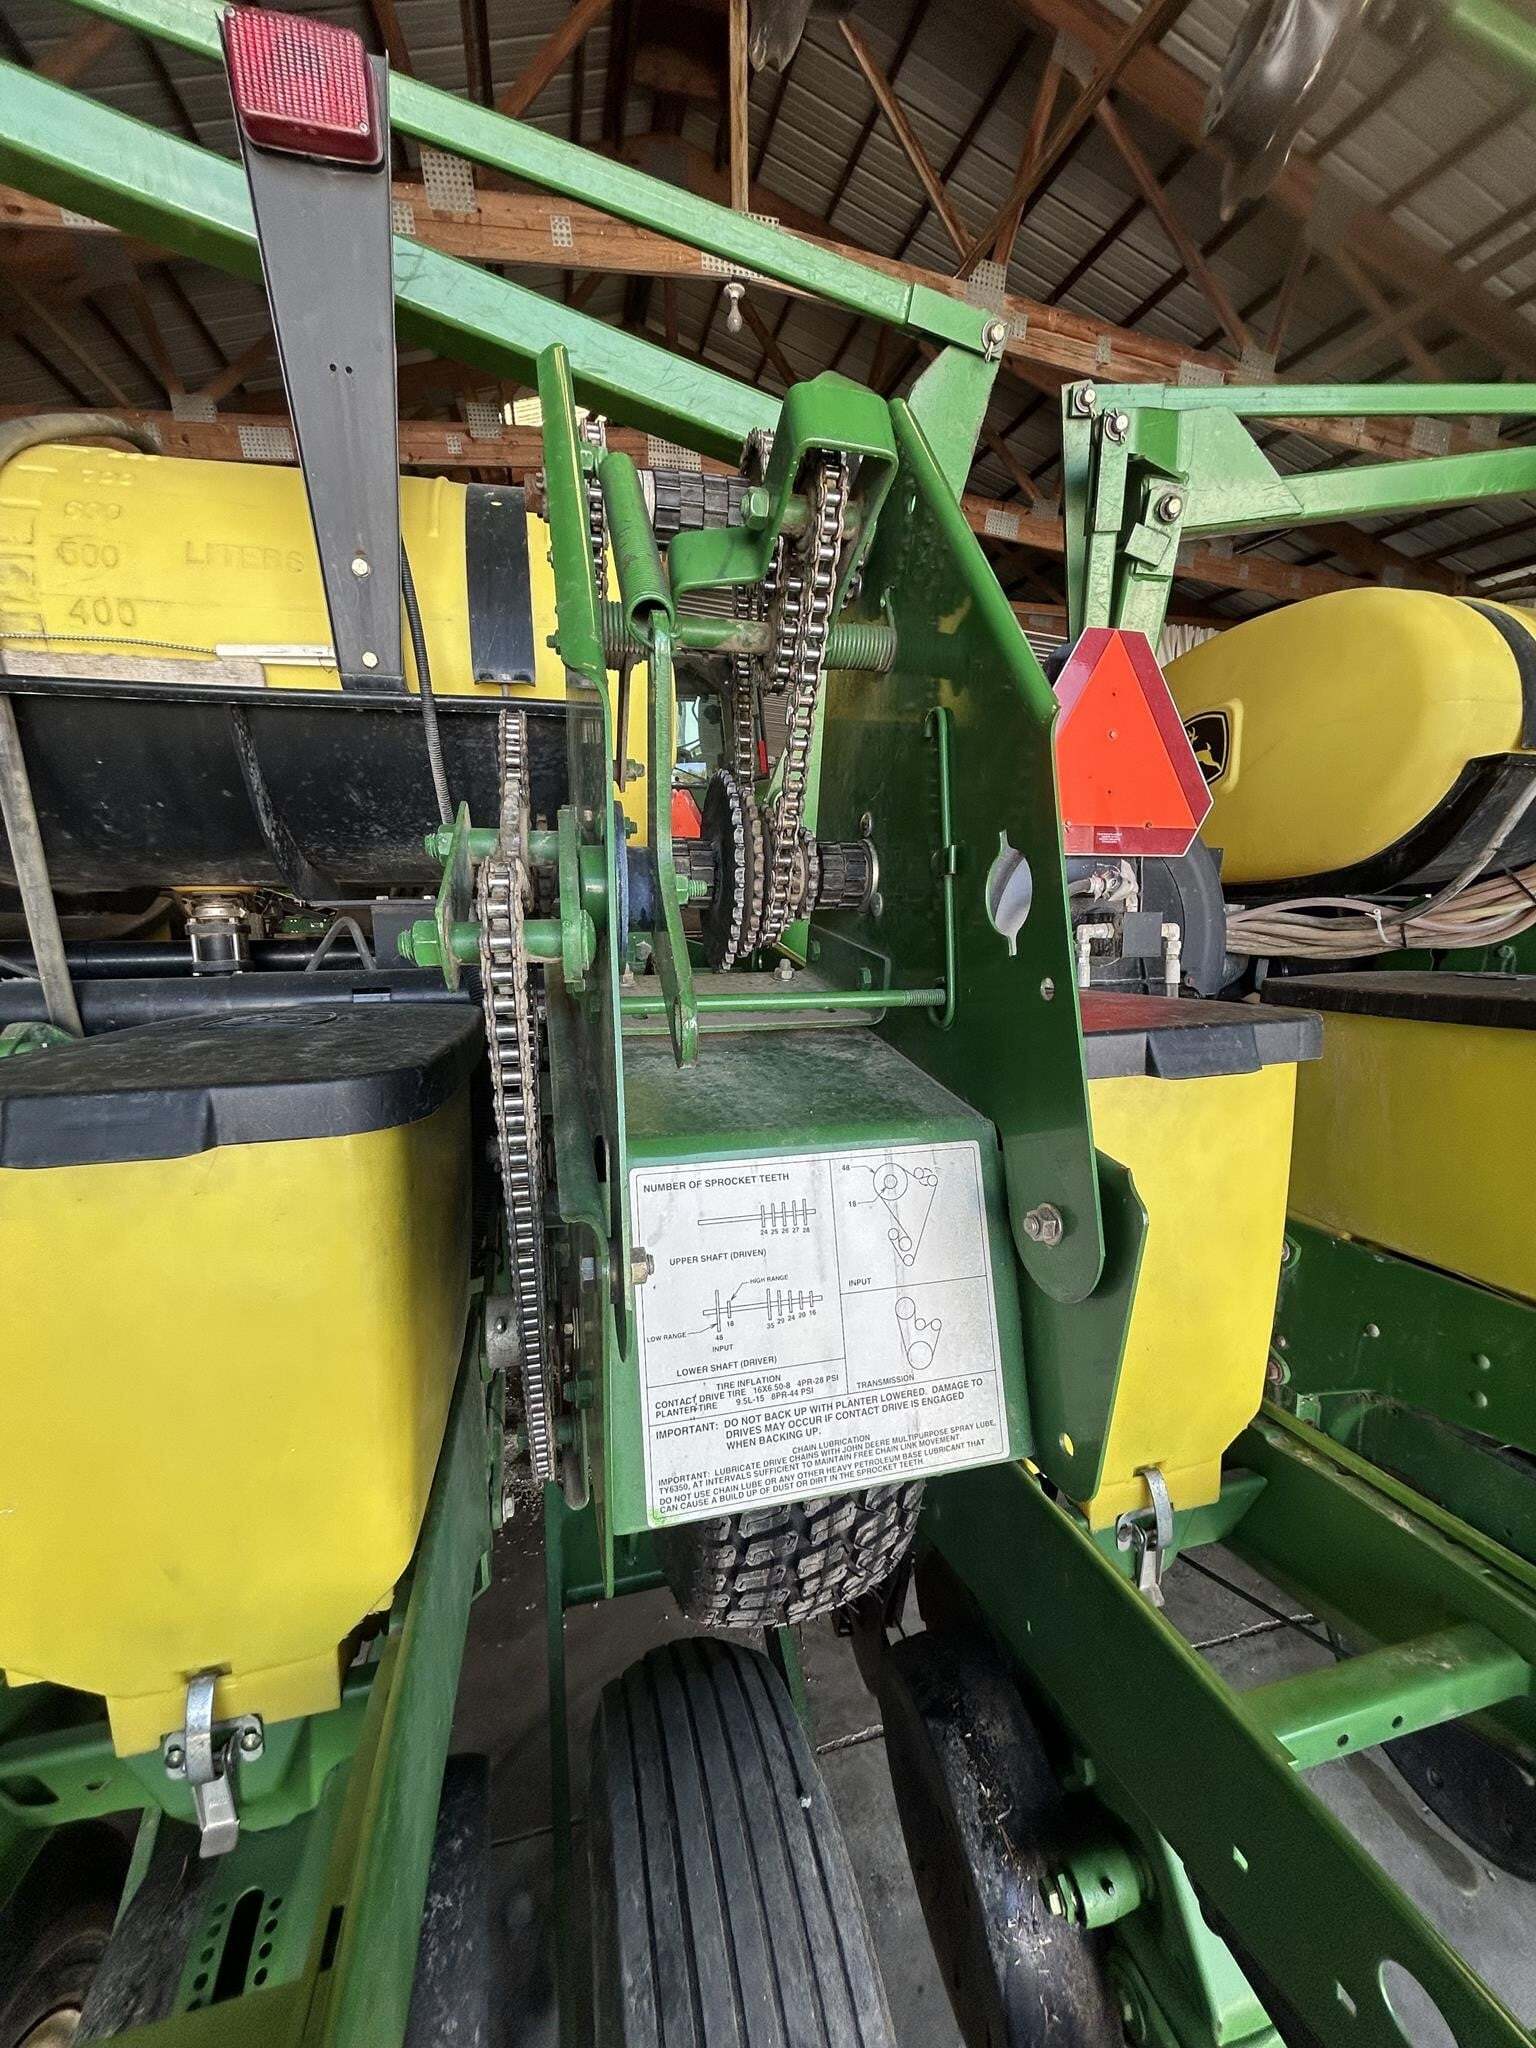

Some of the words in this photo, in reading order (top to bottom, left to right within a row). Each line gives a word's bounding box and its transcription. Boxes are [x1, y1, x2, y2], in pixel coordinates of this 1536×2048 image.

[69, 597, 136, 626] 400
[643, 1181, 686, 1192] NUMBER
[689, 1180, 701, 1188] OF
[705, 1175, 756, 1187] SPROCKET
[670, 1256, 698, 1265] UPPER
[701, 1253, 728, 1262] SHAFT
[731, 1249, 766, 1261] (DRIVEN)
[767, 1274, 788, 1282] RANGE
[849, 1278, 871, 1287] INPUT
[647, 1335, 661, 1343] LOW
[663, 1332, 686, 1340] RANGE
[713, 1344, 733, 1352] INPUT
[677, 1366, 708, 1377] LOWER
[710, 1361, 738, 1372] SHAFT
[740, 1356, 778, 1369] (DRIVER)
[716, 1382, 734, 1390] TIRE
[738, 1375, 781, 1387] INFLATION
[857, 1374, 915, 1389] TRANSMISSION
[655, 1396, 697, 1410] CONTACT
[700, 1392, 724, 1402] DRIVE
[728, 1389, 746, 1397] TIRE
[656, 1422, 718, 1439] IMPORTANT:
[725, 1420, 738, 1428] DO
[742, 1417, 761, 1425] NOT
[765, 1410, 791, 1421] BACK
[794, 1408, 806, 1417] UP
[809, 1402, 832, 1413] WITH
[836, 1395, 878, 1409] PLANTER
[932, 1380, 969, 1393] DAMAGE
[972, 1378, 983, 1387] TO
[655, 1406, 696, 1418] PLANTER
[699, 1402, 718, 1411] TIRE
[726, 1428, 761, 1439] DRIVES
[765, 1422, 785, 1432] MAY
[788, 1416, 822, 1428] OCCUR
[825, 1413, 832, 1422] IF
[836, 1406, 880, 1420] CONTACT
[882, 1400, 908, 1413] DRIVE
[727, 1439, 756, 1450] WHEN
[759, 1430, 802, 1444] BACKING
[806, 1428, 821, 1436] UP.
[792, 1444, 816, 1454] CHAIN
[819, 1434, 870, 1450] LUBRICATION
[659, 1471, 710, 1486] IMPORTANT:
[715, 1463, 761, 1476] LUBRICATE
[764, 1457, 787, 1467] DRIVE
[790, 1452, 819, 1462] CHAINS
[821, 1448, 840, 1457] WITH
[842, 1444, 863, 1452] JOHN
[865, 1440, 890, 1448] DEERE
[892, 1428, 948, 1444] MULTIPURPOSE
[951, 1423, 973, 1433] SPRAY
[706, 1473, 751, 1486] INTERVALS
[754, 1464, 799, 1477] SUFFICIENT
[815, 1454, 852, 1466] MAINTAIN
[854, 1449, 873, 1458] FREE
[876, 1445, 898, 1455] CHAIN
[901, 1442, 917, 1450] LINK
[660, 1497, 672, 1505] DO
[674, 1494, 691, 1502] NOT
[714, 1486, 738, 1495] CHAIN
[741, 1481, 762, 1490] LUBE
[765, 1478, 776, 1486] OR
[779, 1475, 795, 1483] ANY
[798, 1469, 824, 1479] OTHER
[826, 1463, 852, 1473] HEAVY
[855, 1455, 901, 1469] PETROLEUM
[903, 1451, 922, 1459] BASE
[925, 1442, 965, 1455] LUBRICANT
[967, 1439, 985, 1447] THAT
[660, 1505, 677, 1513] CAN
[680, 1499, 708, 1510] CAUSE
[720, 1492, 744, 1502] BUILD
[746, 1489, 756, 1497] UP
[760, 1486, 770, 1494] OF
[773, 1483, 794, 1492] DUST
[810, 1476, 827, 1485] DIRT
[840, 1471, 854, 1480] THE
[857, 1462, 897, 1477] SPROCKET
